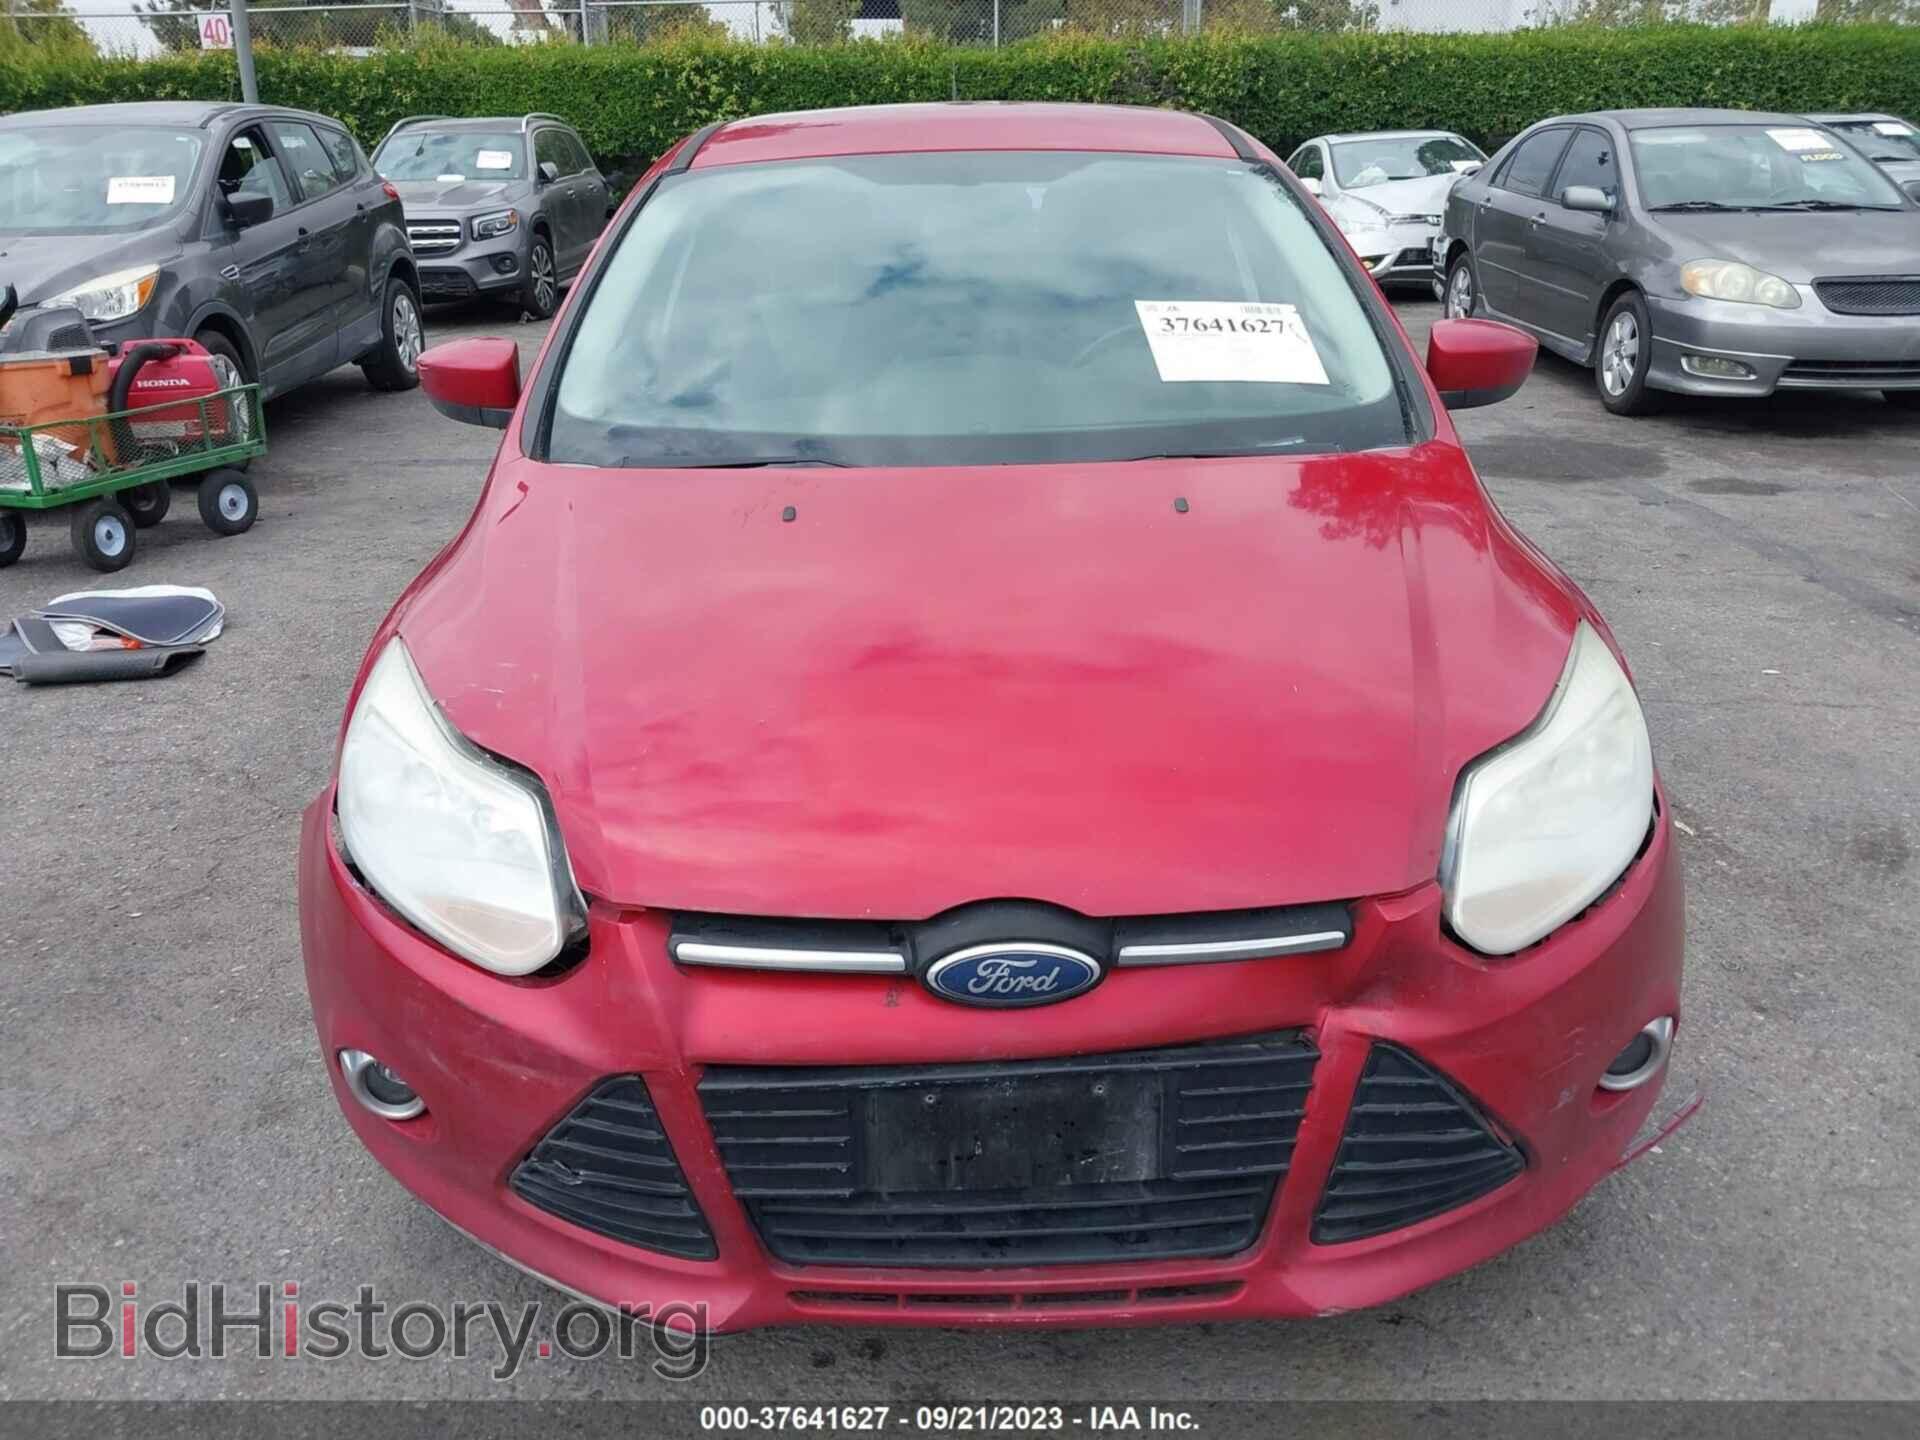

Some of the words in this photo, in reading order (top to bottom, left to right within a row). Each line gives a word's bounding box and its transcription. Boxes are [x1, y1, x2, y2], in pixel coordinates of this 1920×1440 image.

[203, 17, 228, 45] 40
[1160, 317, 1284, 334] 37641627
[136, 378, 191, 389] HONDA
[967, 958, 1061, 994] Ford
